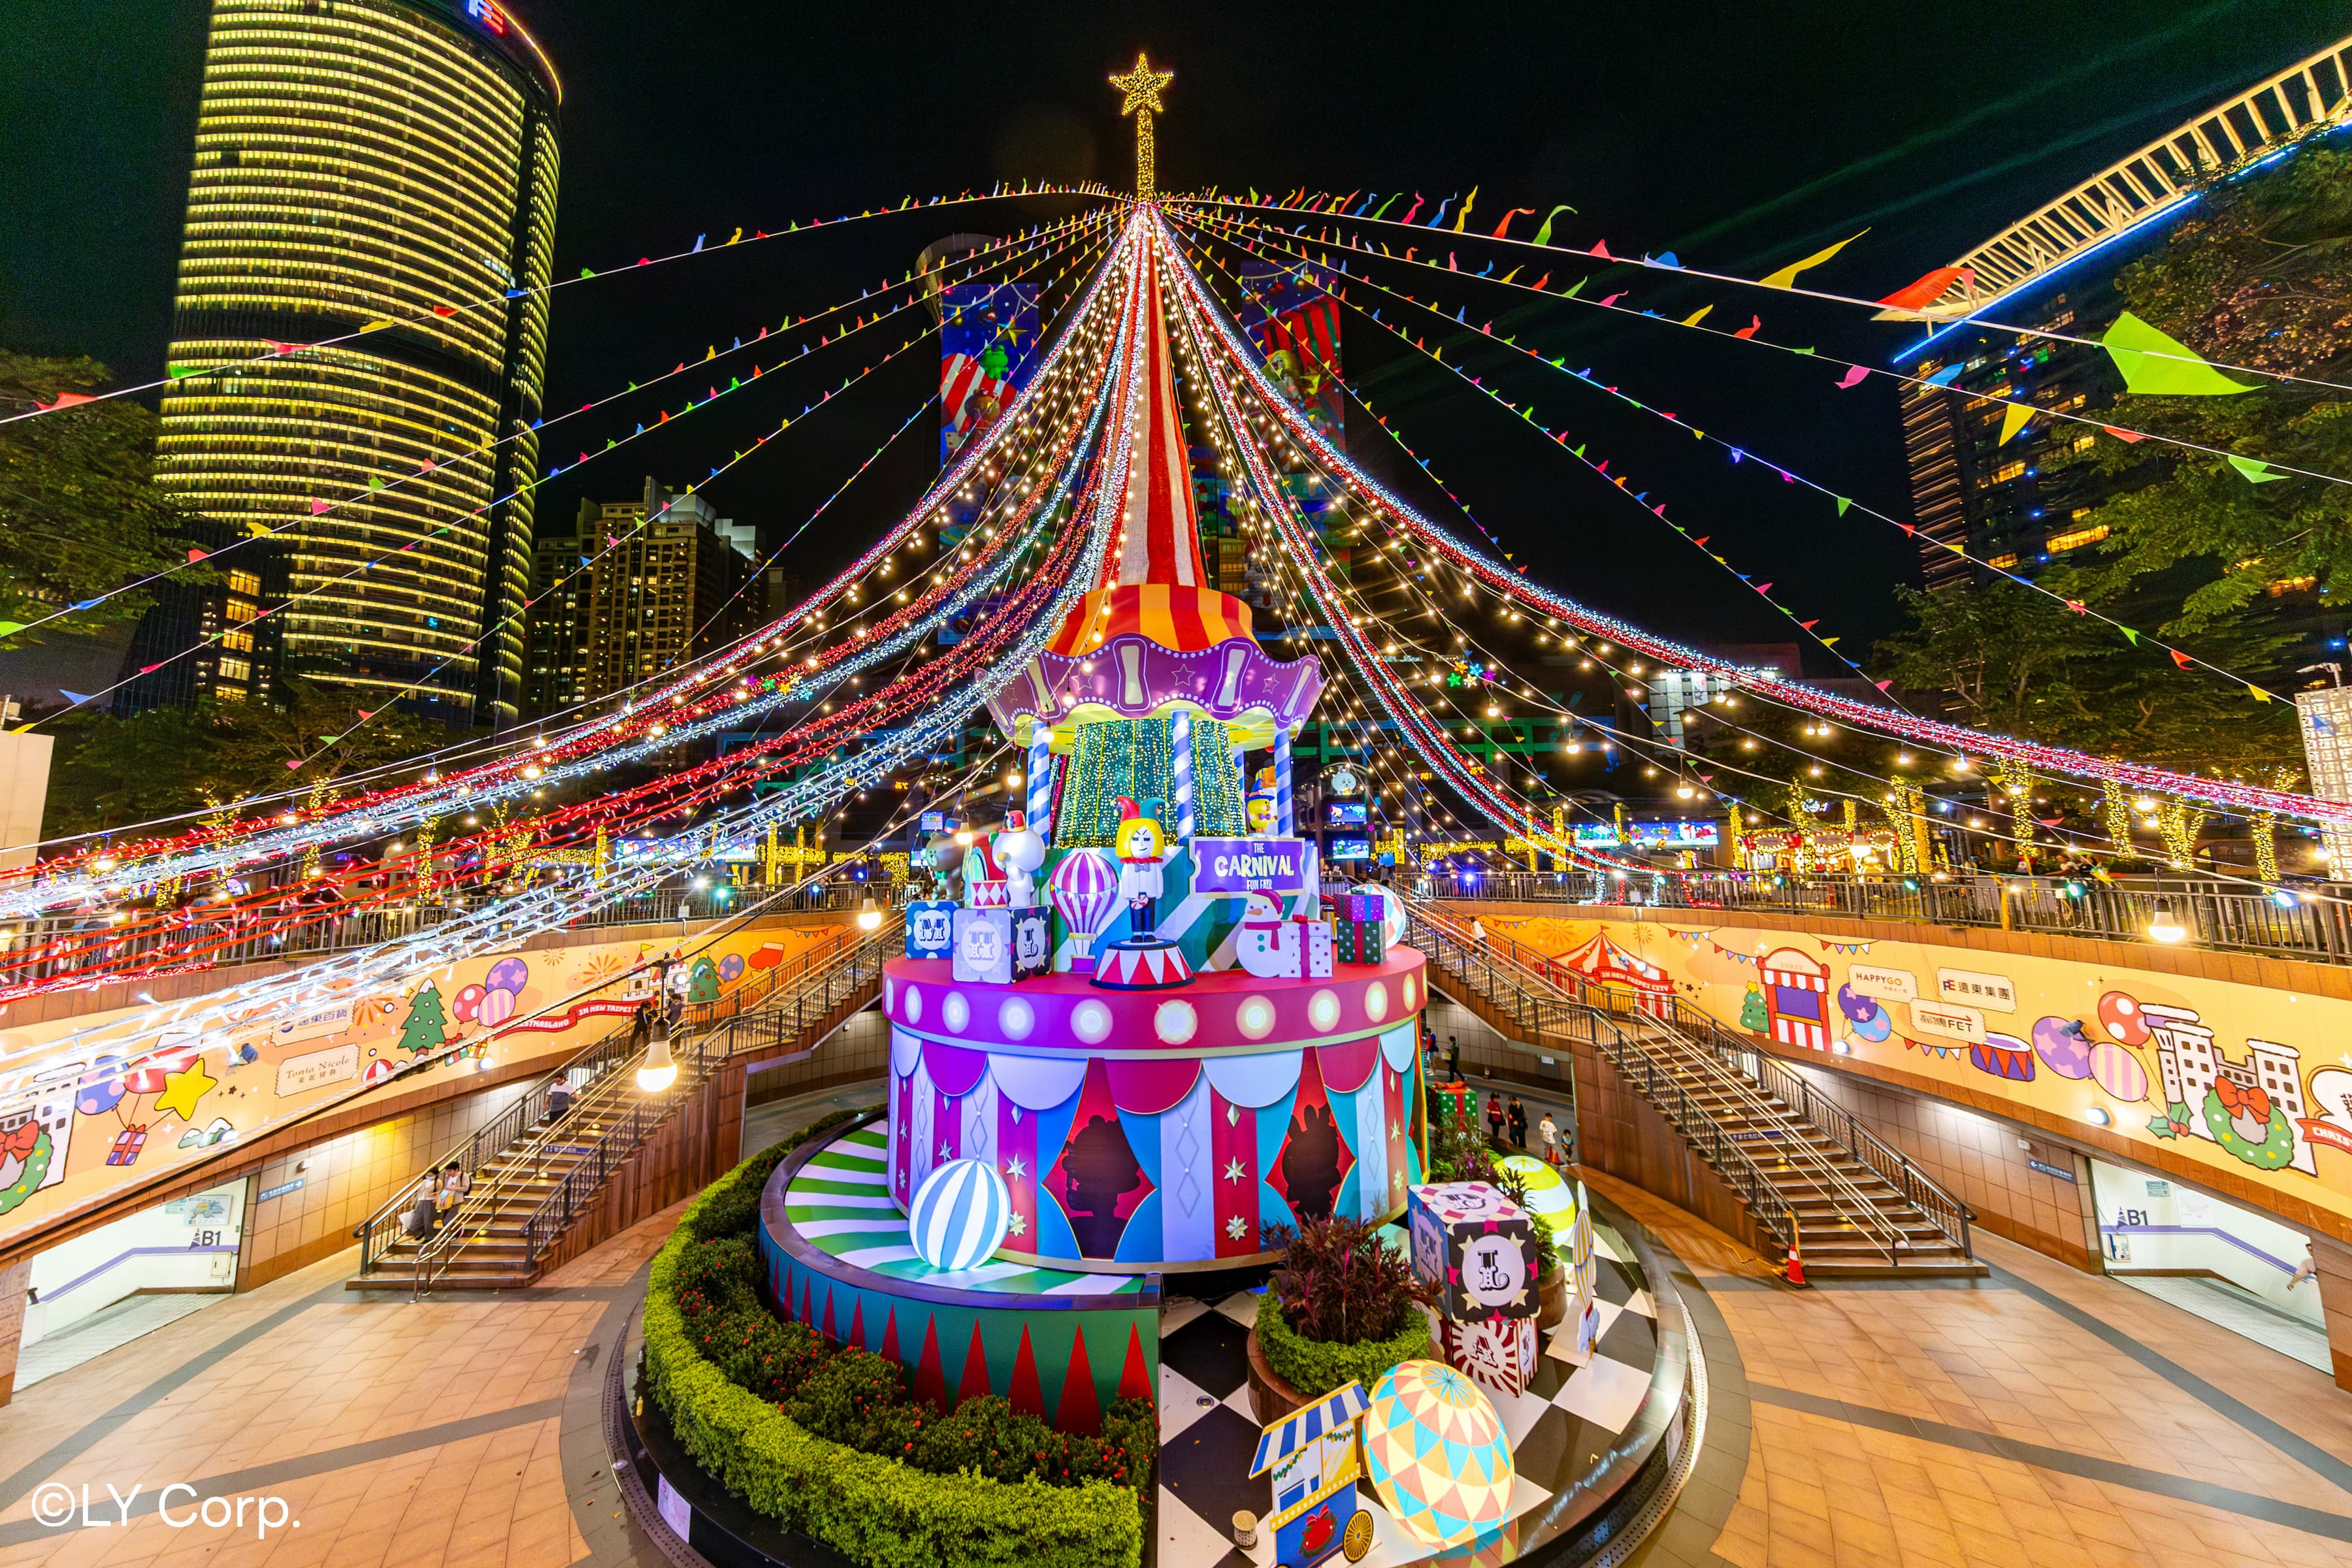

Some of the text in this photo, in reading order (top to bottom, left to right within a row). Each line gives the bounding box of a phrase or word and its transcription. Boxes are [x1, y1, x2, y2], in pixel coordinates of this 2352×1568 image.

[1254, 843, 1265, 853] THE
[1214, 854, 1295, 877] CARNIVAL
[1247, 879, 1273, 890] FUN FAIR
[1024, 928, 1039, 958] L
[1856, 972, 1903, 987] HAPPYGO
[1959, 981, 2010, 1000] 遠東集團
[1948, 1020, 1972, 1032] FET
[286, 1055, 350, 1079] Tonia Nicole
[2313, 1126, 2352, 1147] CHRIS
[2127, 1209, 2149, 1226] B1
[201, 1230, 221, 1247] B1
[1477, 1250, 1510, 1292] L
